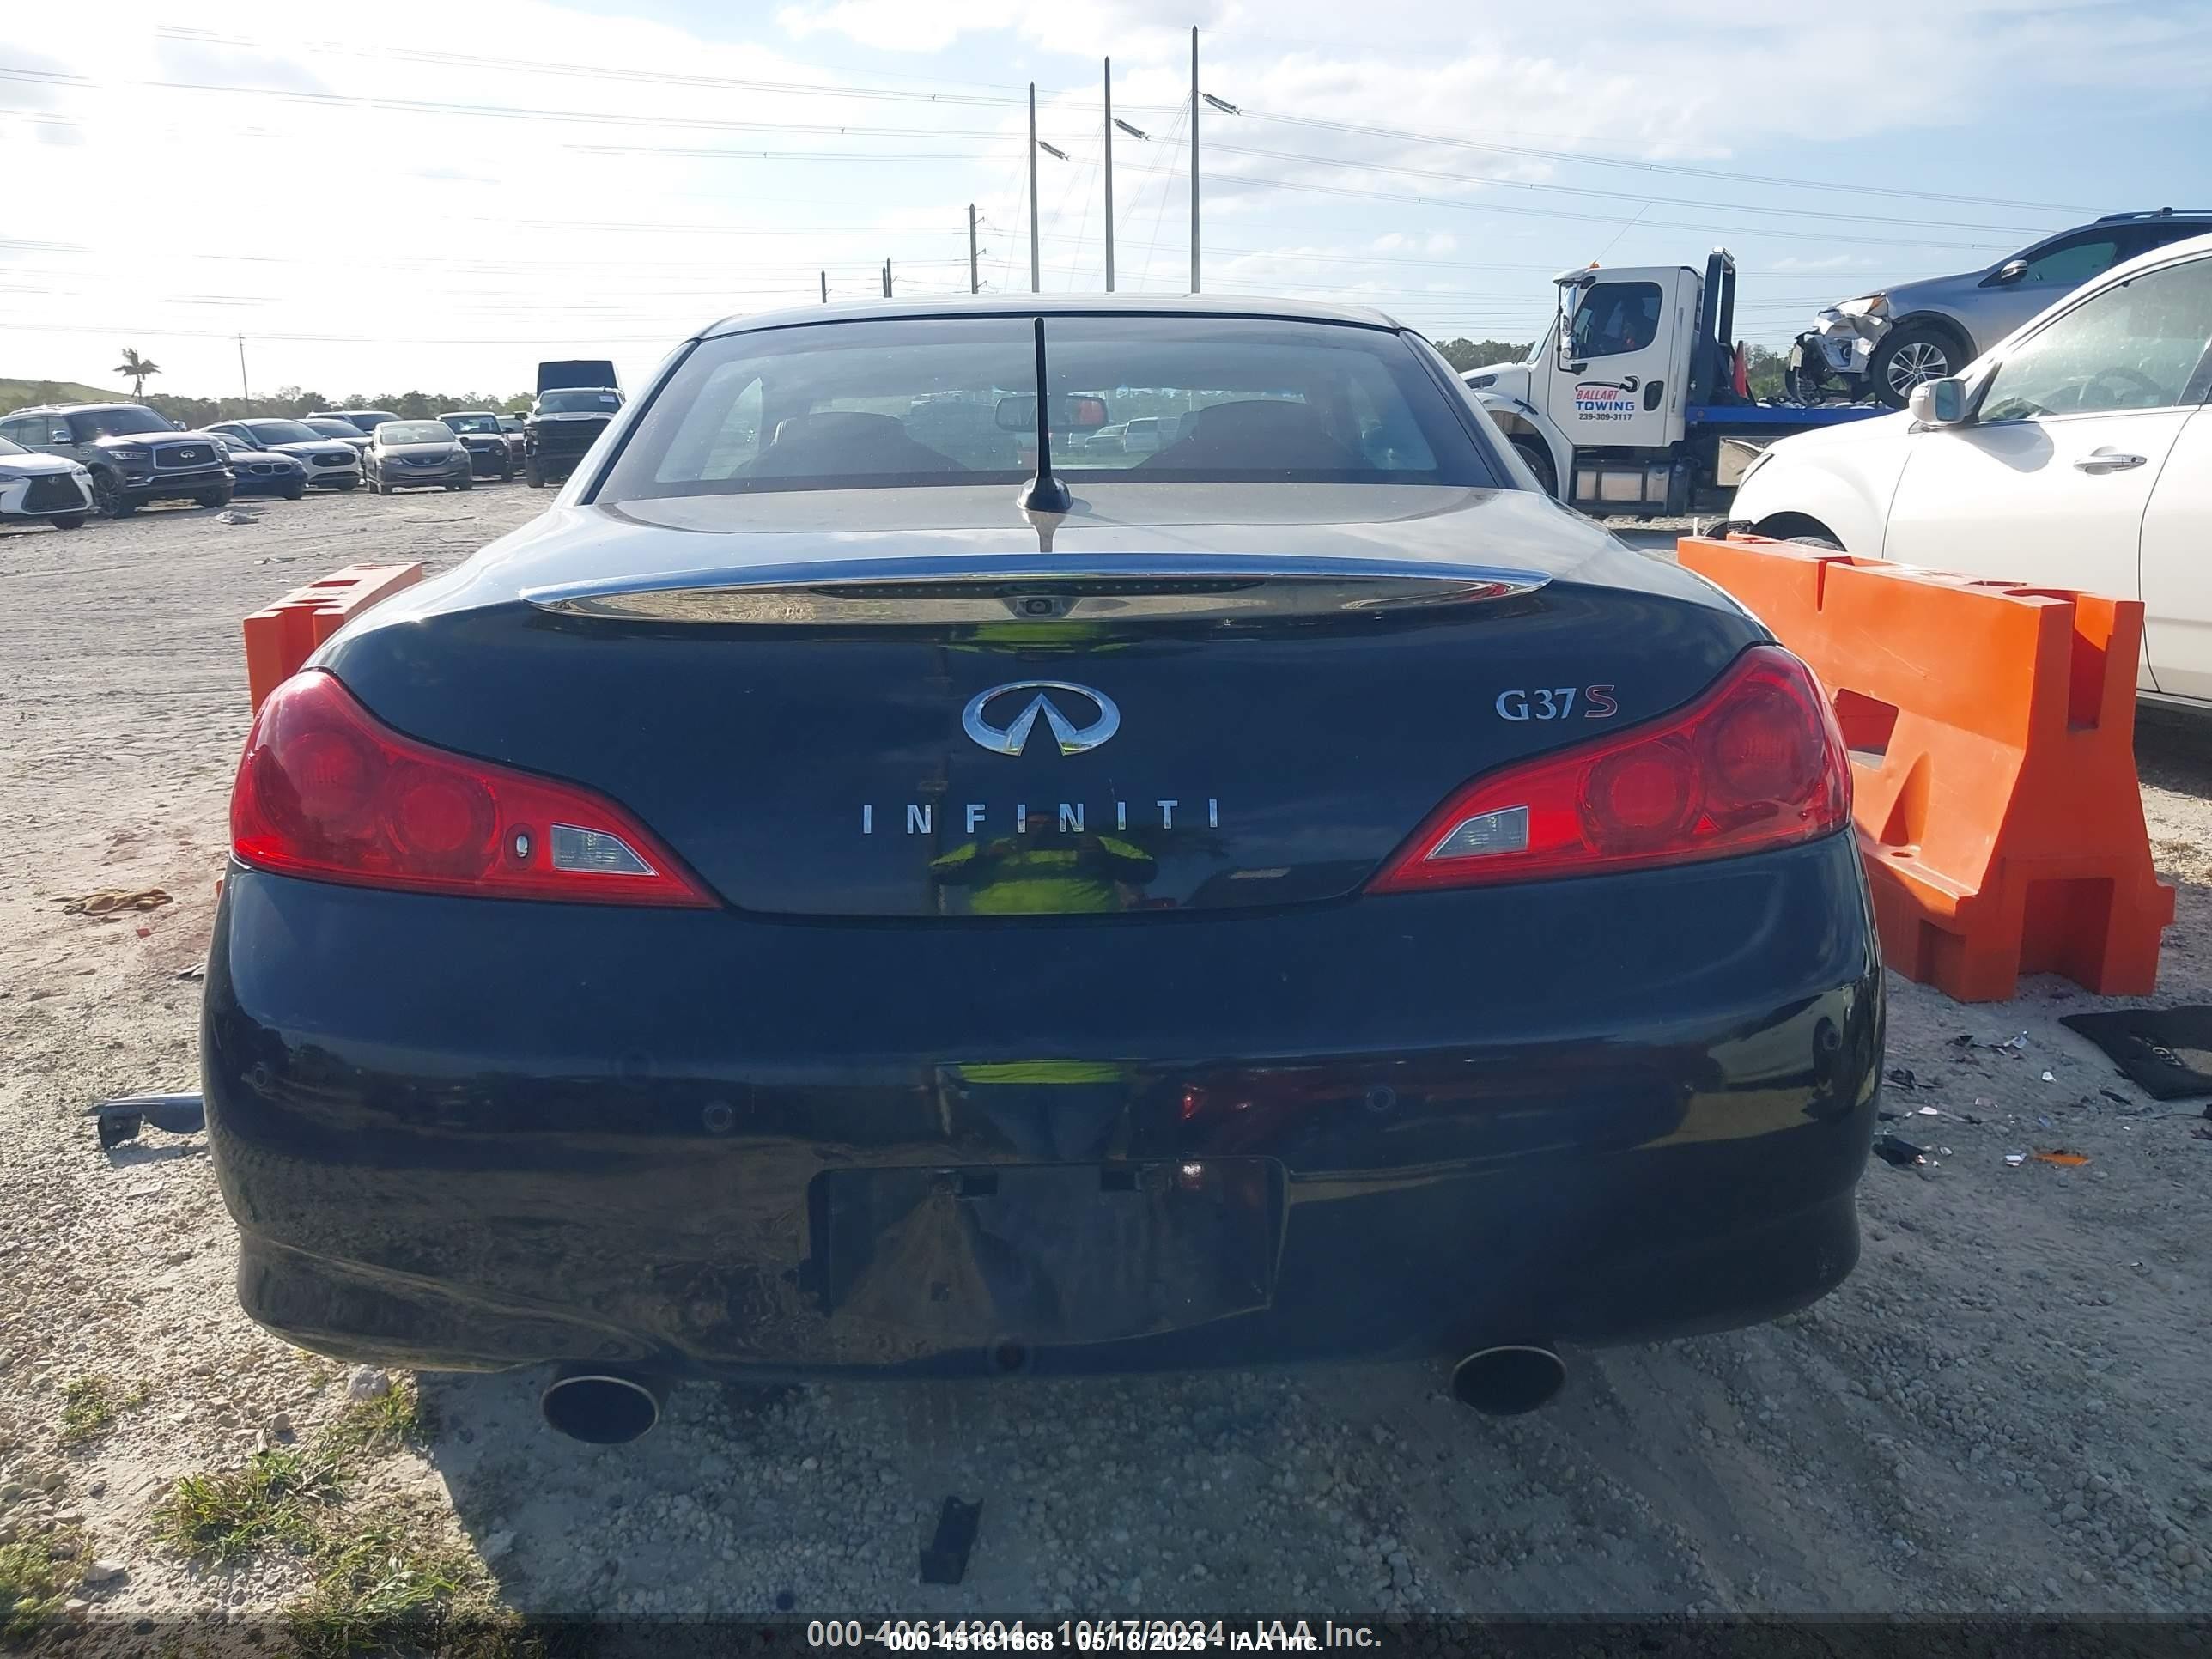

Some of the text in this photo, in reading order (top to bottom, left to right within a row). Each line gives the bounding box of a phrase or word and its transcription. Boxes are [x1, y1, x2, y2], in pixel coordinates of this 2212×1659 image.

[1576, 390, 1620, 400] BALLART
[1576, 401, 1635, 411] TOWING
[862, 799, 1218, 835] INFINITI
